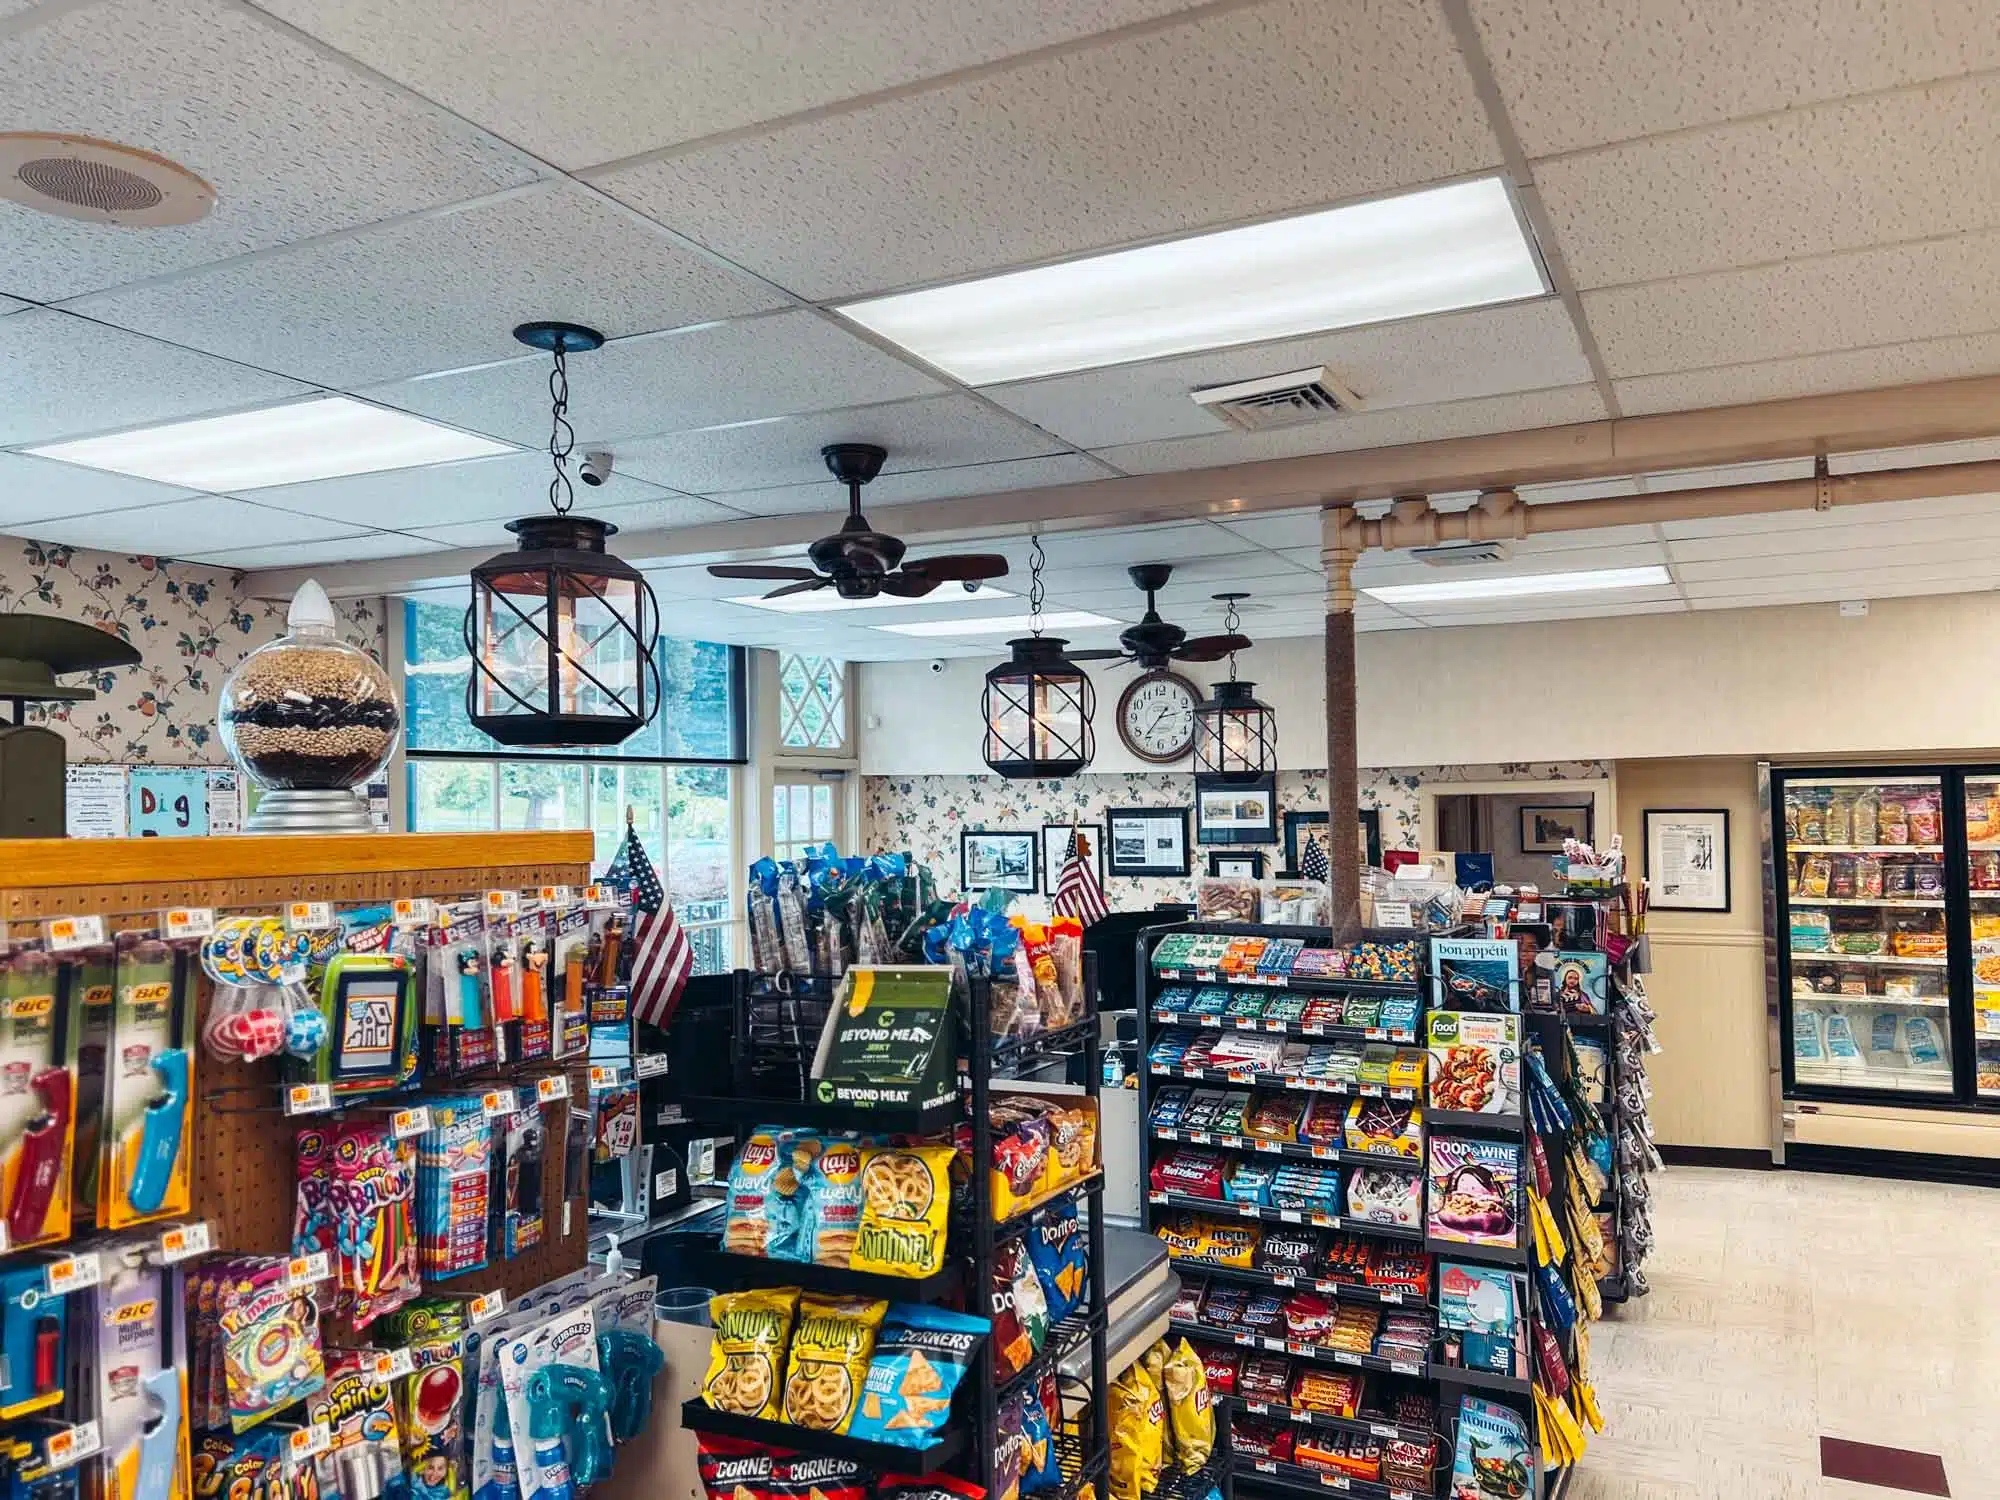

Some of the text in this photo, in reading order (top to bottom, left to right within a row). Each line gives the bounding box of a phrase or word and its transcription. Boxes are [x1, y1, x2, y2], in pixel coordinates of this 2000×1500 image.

[1143, 690, 1151, 700] 11
[1156, 686, 1166, 696] 12
[1172, 688, 1176, 699] 1
[1133, 699, 1144, 710] 10
[1181, 698, 1188, 708] 2
[1130, 713, 1138, 723] 9
[1185, 711, 1192, 722] 3
[1134, 727, 1142, 737] 8
[1145, 736, 1152, 746] 7
[1157, 739, 1164, 750] 6
[1171, 736, 1178, 746] 5
[141, 787, 190, 828] Dig
[1439, 944, 1509, 958] bon appétit
[840, 1027, 928, 1043] BEYOND MEAT
[1432, 1020, 1459, 1036] food
[837, 1088, 912, 1102] BEYOND MEAT
[745, 1143, 775, 1165] Lay's
[1432, 1141, 1517, 1161] FOOD & WINE
[823, 1155, 857, 1175] Lay's
[1161, 1164, 1204, 1179] Twizzlers
[733, 1177, 771, 1196] wavy
[820, 1186, 862, 1204] wavy
[119, 1327, 155, 1346] purpose
[552, 1323, 592, 1351] FUBBLES
[332, 1375, 363, 1399] METAL
[203, 1438, 234, 1454] Color
[1232, 1443, 1269, 1456] Skittles
[234, 1459, 264, 1475] Color
[717, 1458, 772, 1478] CORNE
